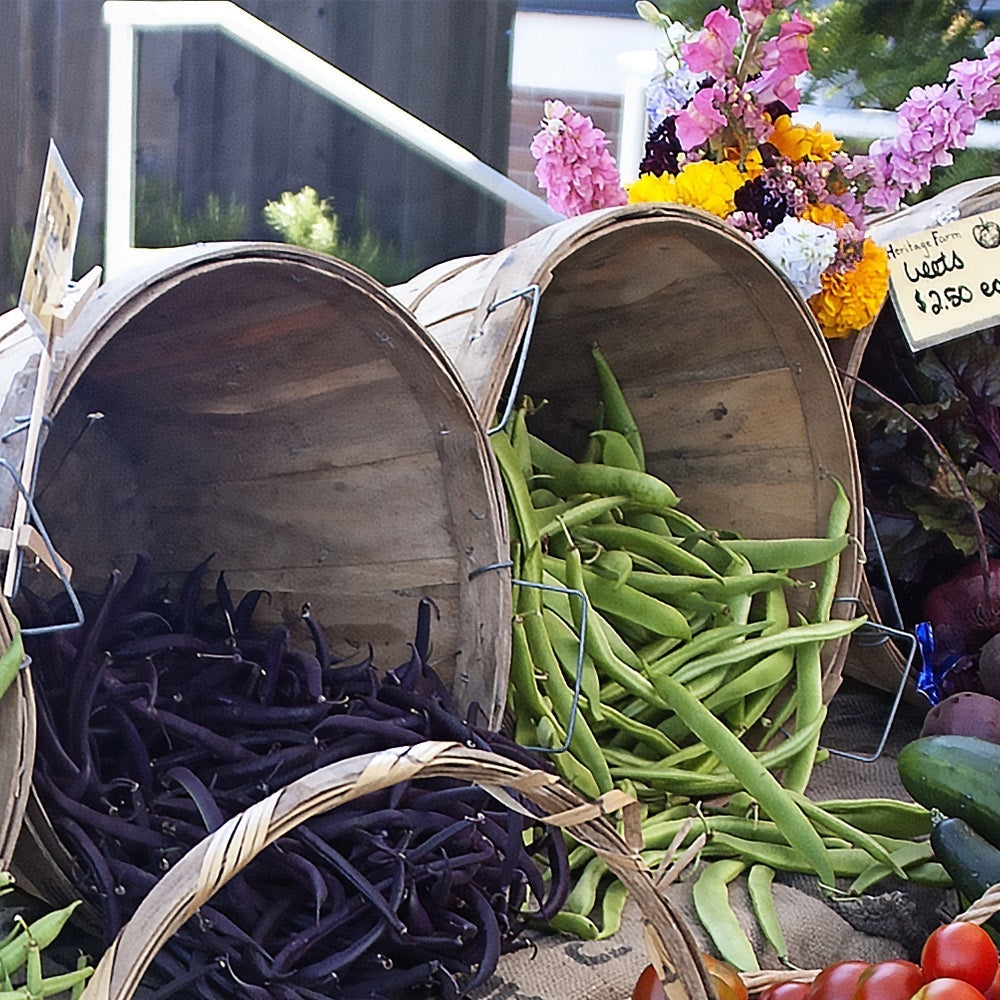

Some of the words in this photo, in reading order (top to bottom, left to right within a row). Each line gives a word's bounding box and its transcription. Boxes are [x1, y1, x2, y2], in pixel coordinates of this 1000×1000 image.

[886, 241, 931, 259] Heritage
[931, 231, 962, 246] Farm
[915, 285, 973, 315] $2.50
